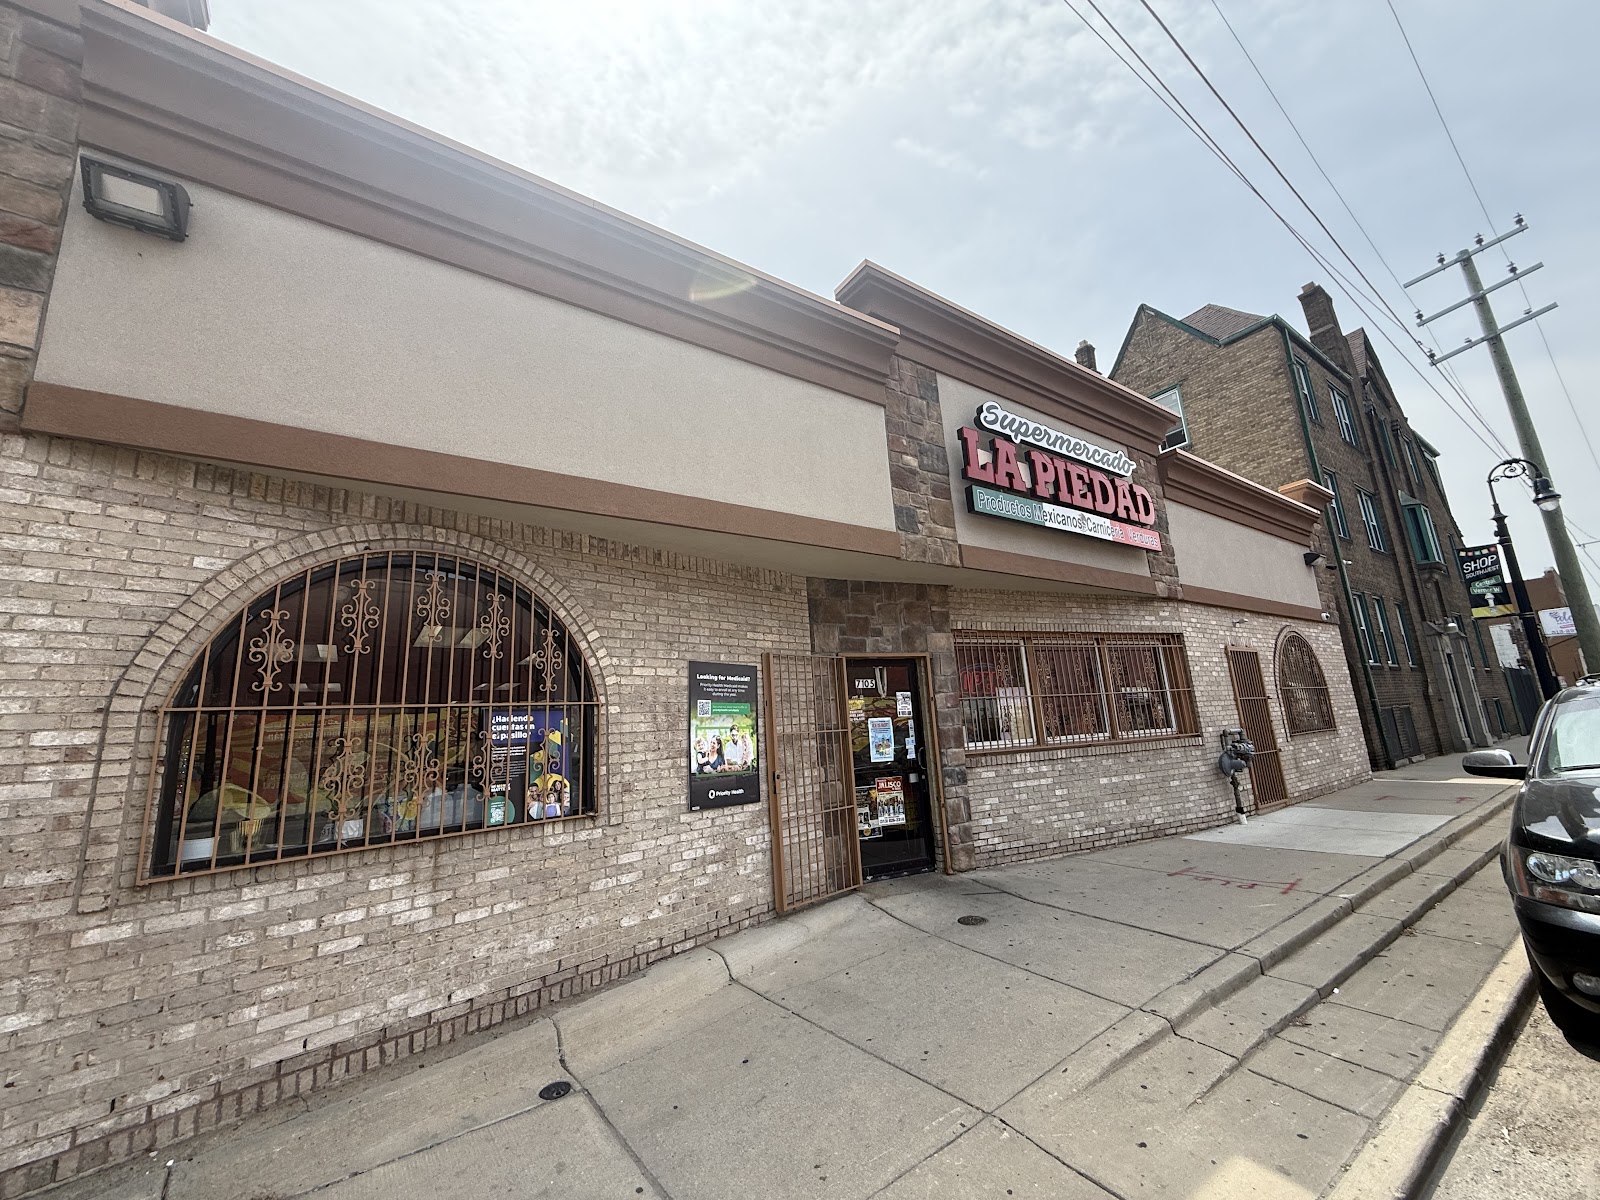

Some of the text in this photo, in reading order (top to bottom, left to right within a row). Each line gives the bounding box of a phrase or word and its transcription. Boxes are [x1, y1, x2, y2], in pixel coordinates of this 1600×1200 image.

[982, 403, 1135, 475] Supermercado
[962, 427, 1156, 525] LA PIEDAD
[976, 489, 1032, 520] Productos
[1033, 502, 1082, 530] Mexicanos
[1127, 526, 1159, 548] Verduras
[1463, 555, 1497, 573] SHOP
[1465, 564, 1500, 579] SOUTHWEST
[856, 680, 875, 688] 7105
[877, 781, 901, 789] JALISCO
